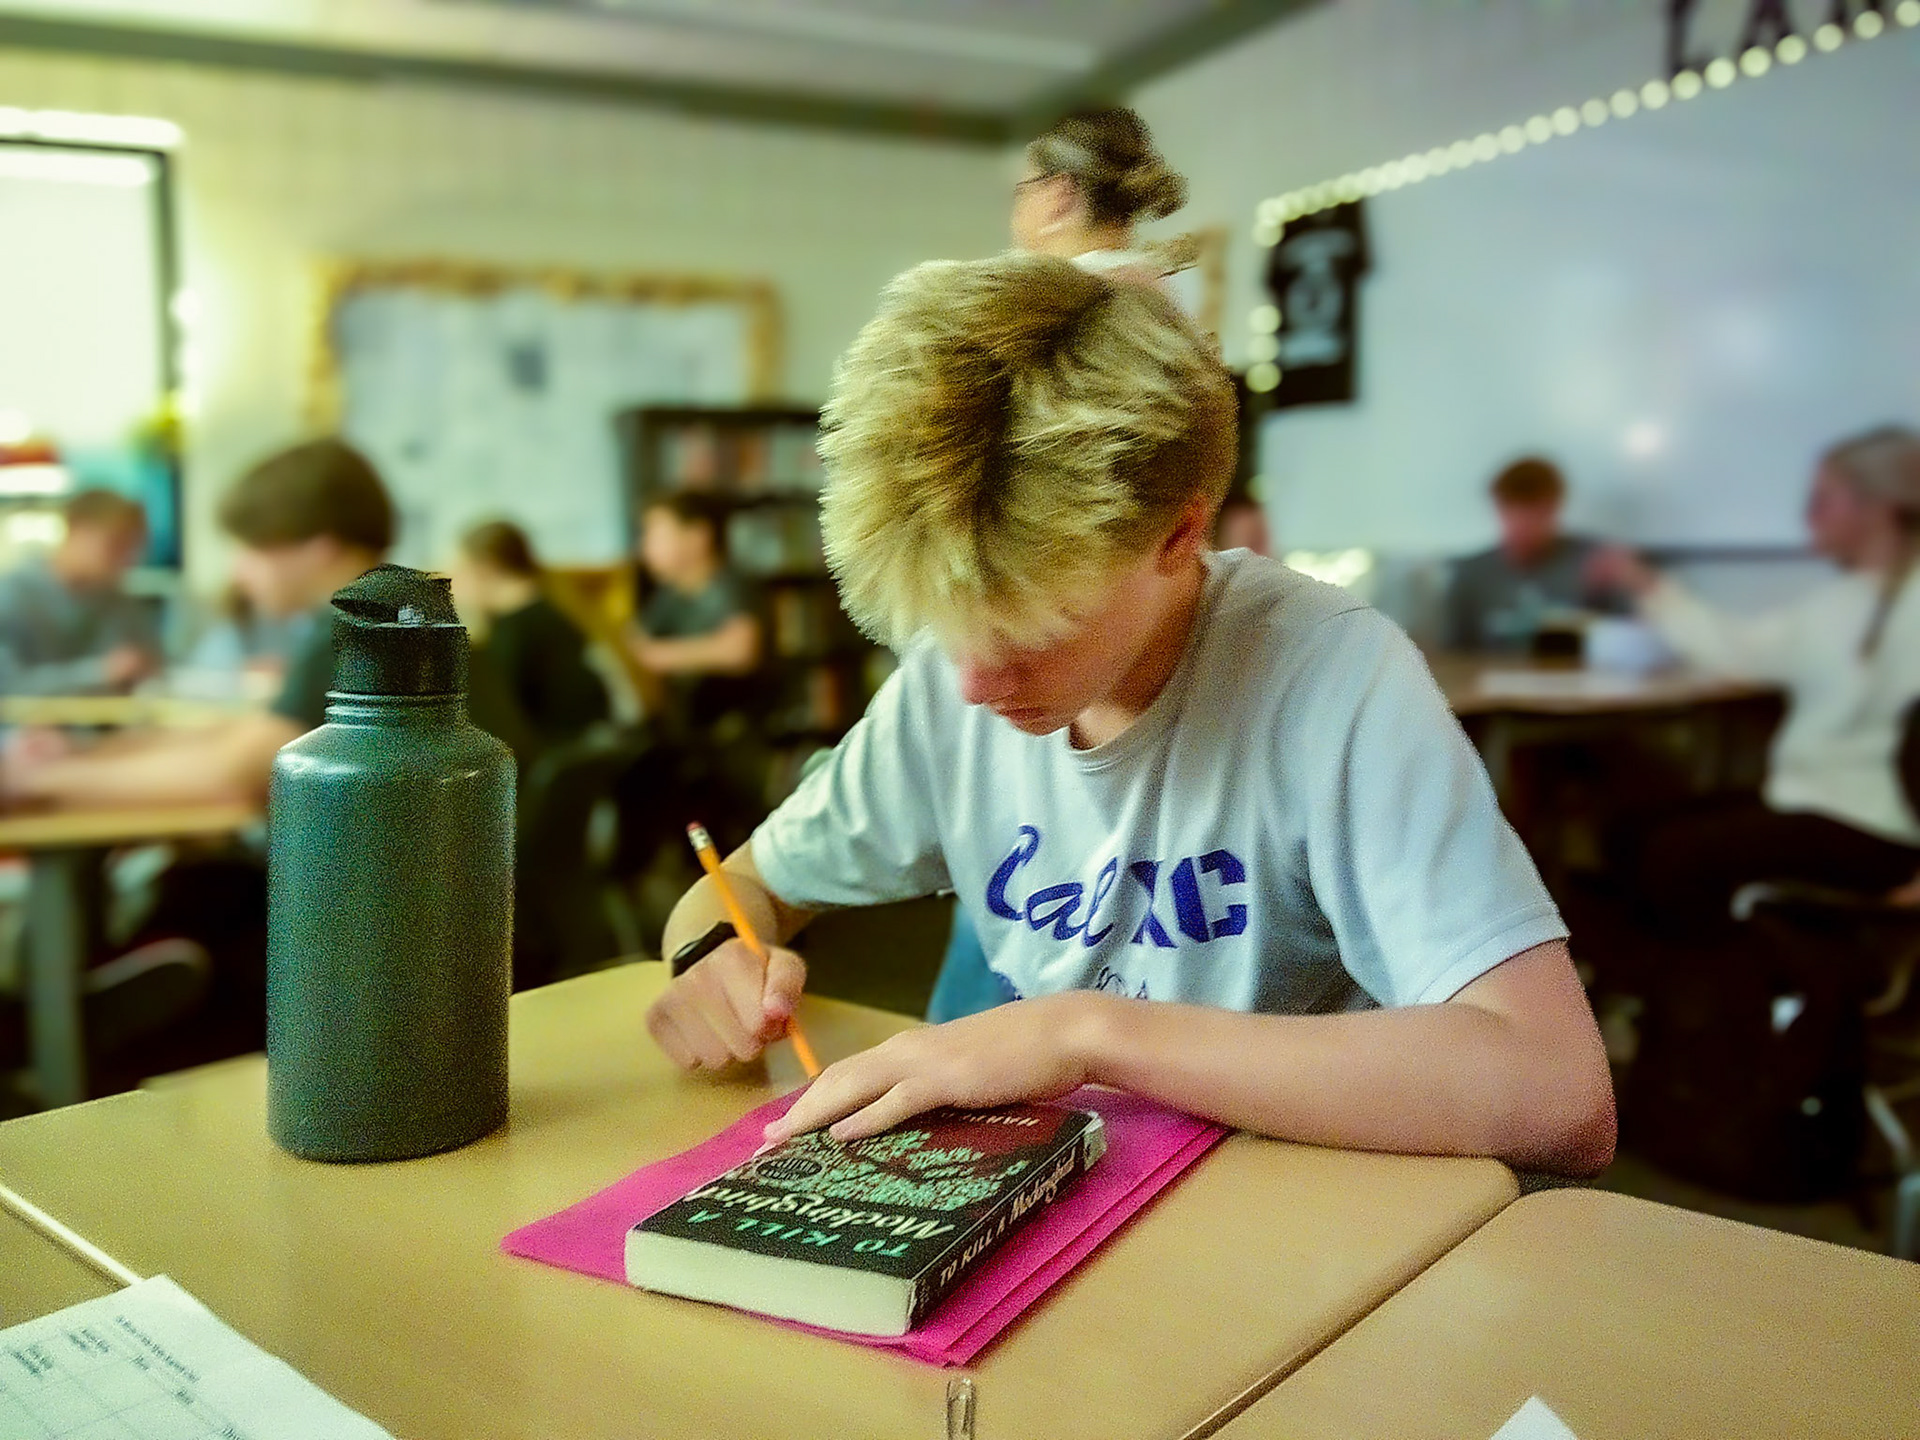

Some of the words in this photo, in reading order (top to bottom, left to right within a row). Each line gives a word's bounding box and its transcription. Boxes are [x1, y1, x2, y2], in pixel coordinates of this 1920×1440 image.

[986, 824, 1117, 947] Cal
[1130, 849, 1248, 949] XC
[682, 1186, 956, 1240] Mockingbird
[687, 1209, 723, 1224] A
[735, 1217, 842, 1247] KILL
[853, 1239, 911, 1258] TO
[940, 1259, 958, 1288] TO
[961, 1228, 993, 1270] KILL
